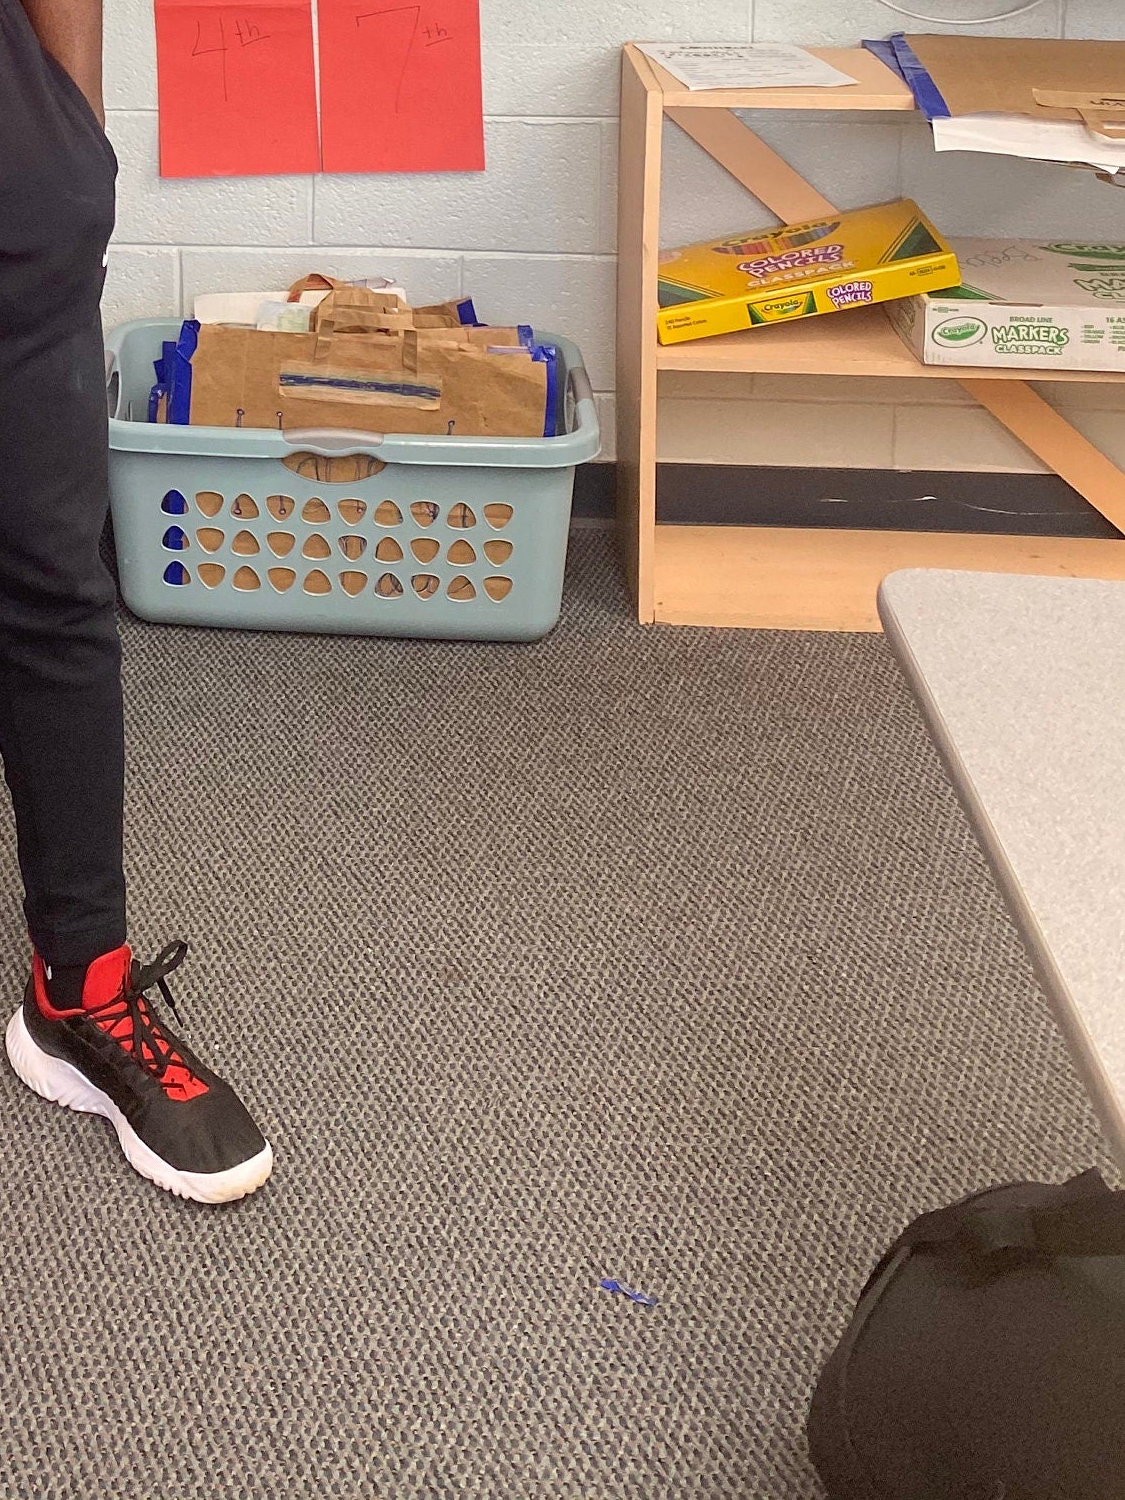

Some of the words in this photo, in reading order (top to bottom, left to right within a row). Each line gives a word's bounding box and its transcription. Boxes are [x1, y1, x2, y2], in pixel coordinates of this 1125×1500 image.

[739, 245, 842, 271] COLORED
[749, 253, 841, 278] PENCILS
[747, 262, 855, 288] CLASSPACK
[826, 282, 872, 299] COLORED
[832, 290, 873, 308] PENCILS
[762, 300, 801, 314] Crayola
[992, 325, 1069, 345] MARKERS
[995, 345, 1063, 355] CLASSPACK
